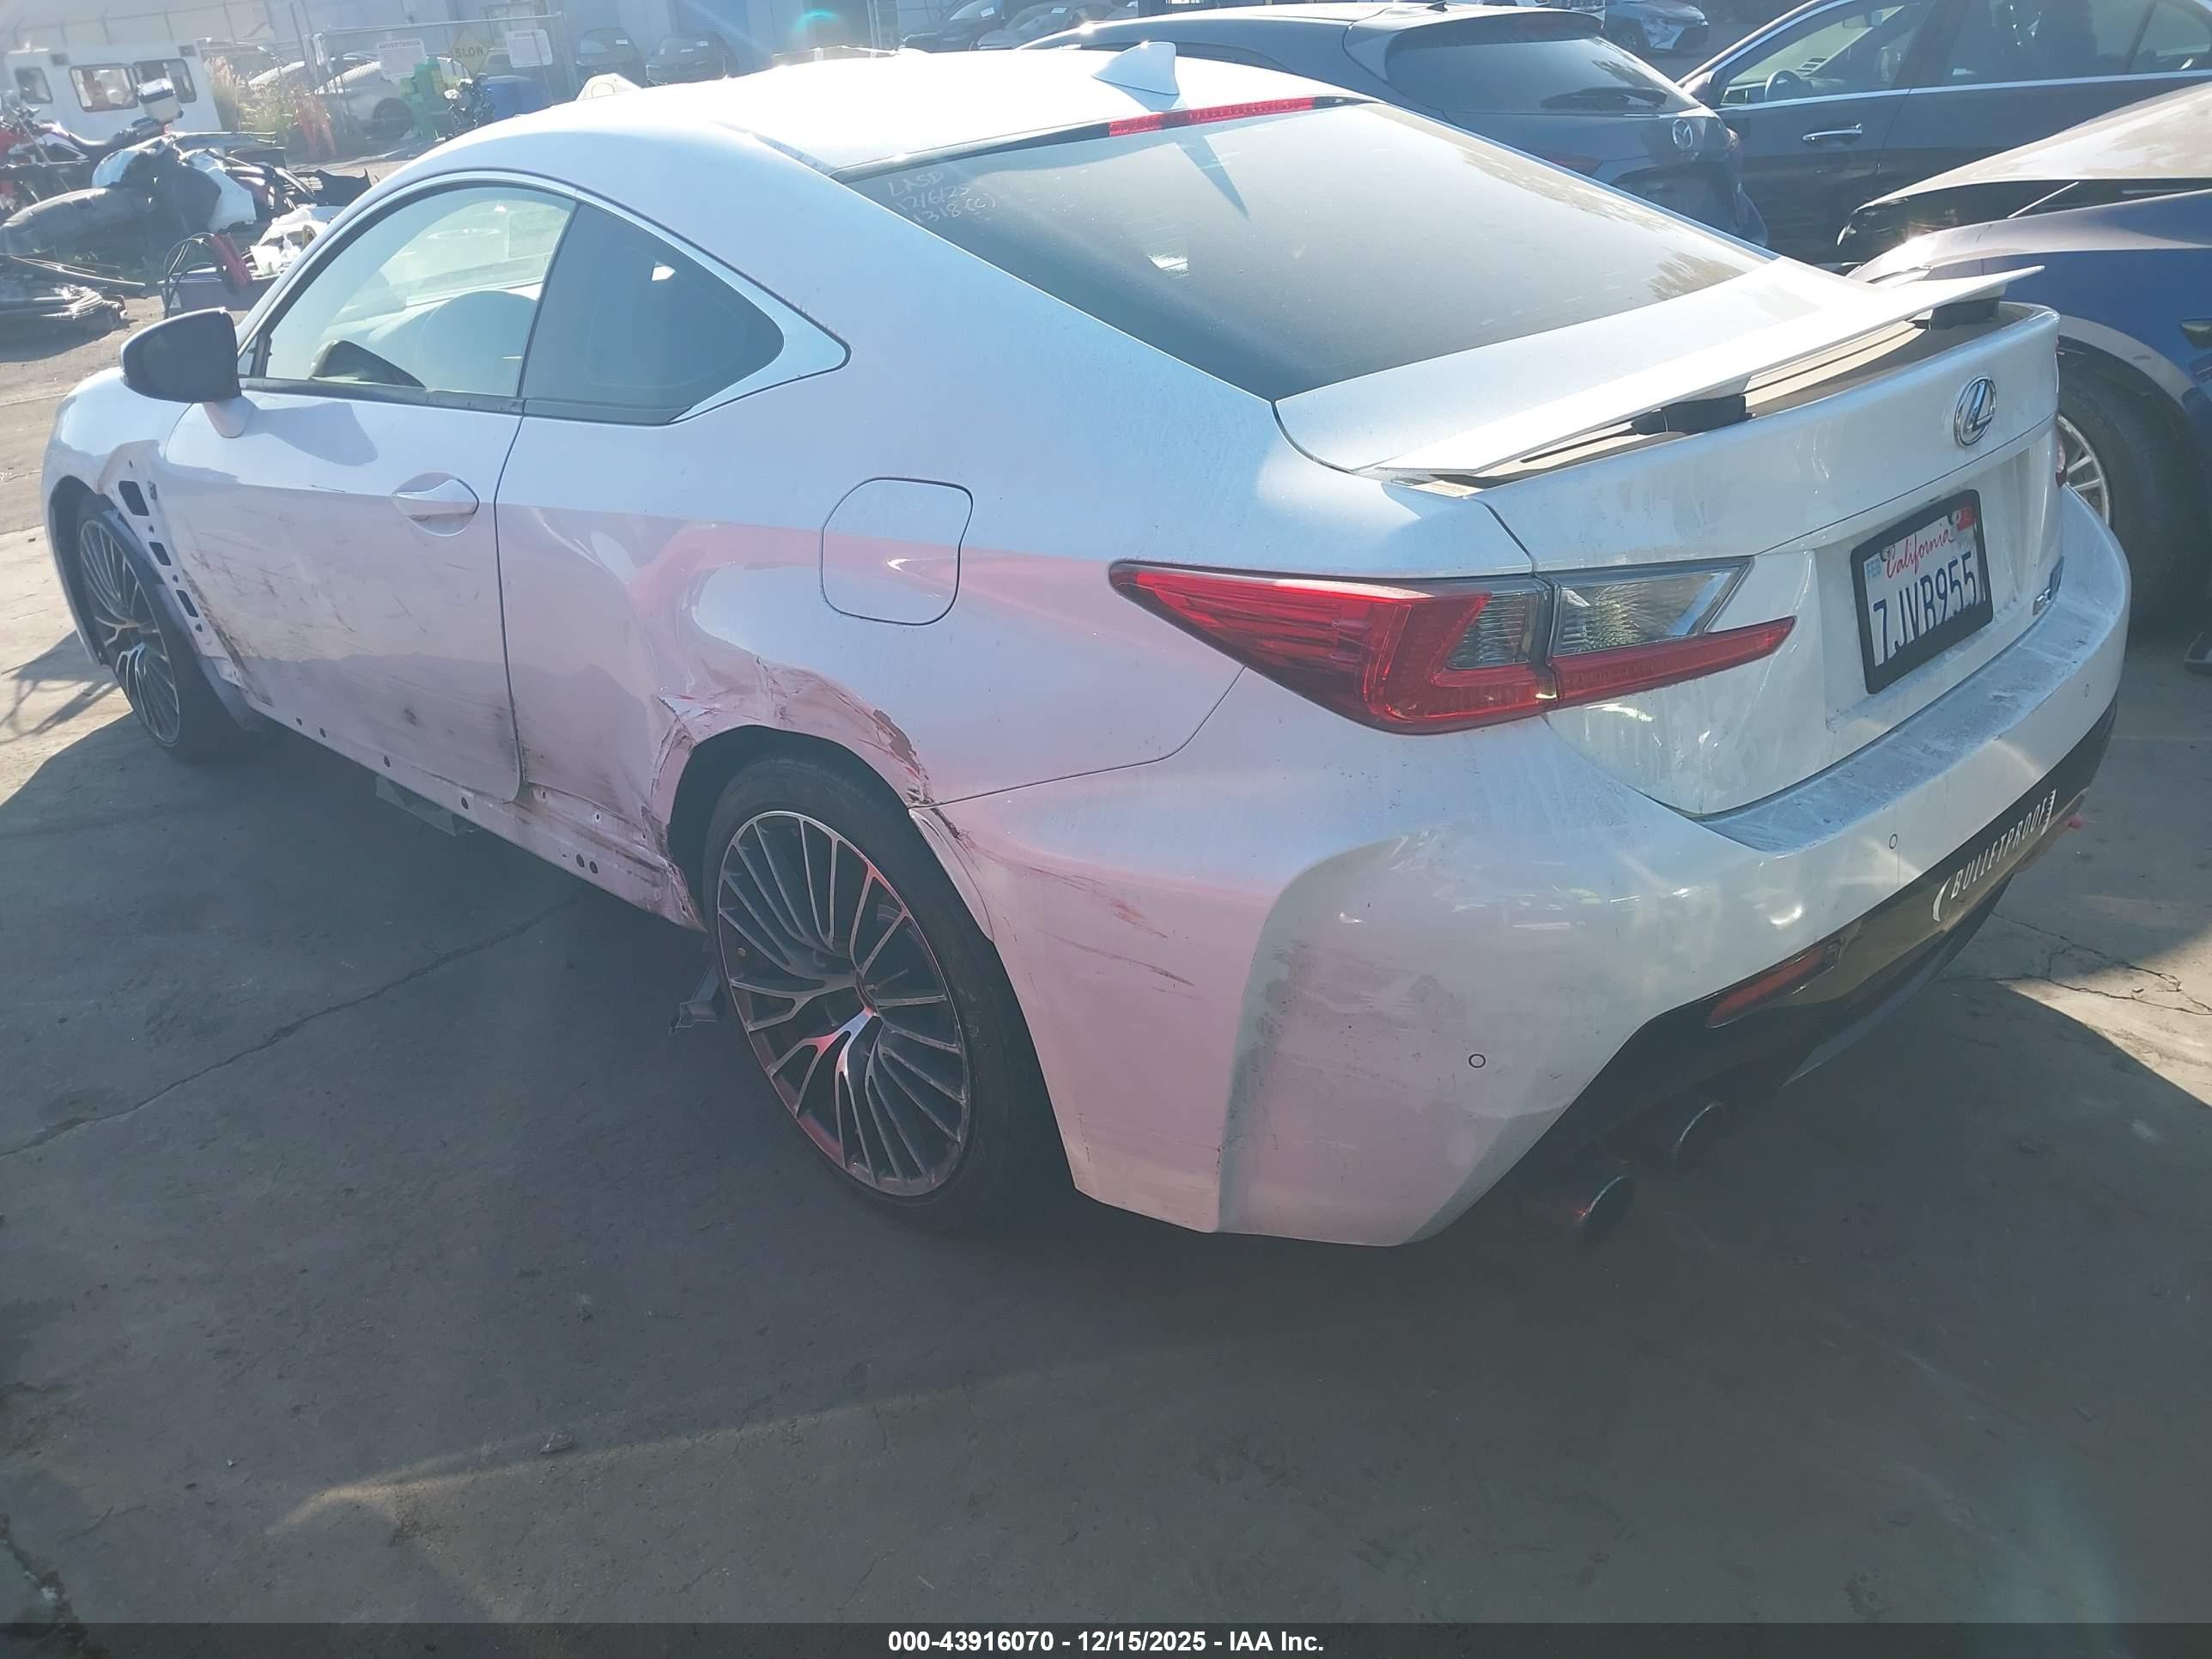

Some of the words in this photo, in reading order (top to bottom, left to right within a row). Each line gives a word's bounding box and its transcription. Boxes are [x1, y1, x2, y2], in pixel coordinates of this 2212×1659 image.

[454, 46, 484, 59] SLOW
[888, 172, 944, 197] LASD
[896, 184, 972, 210] 12/6/25
[1884, 527, 1954, 580] California
[1873, 550, 1977, 659] 7JVB955
[1950, 796, 2048, 900] BULLETPROOF
